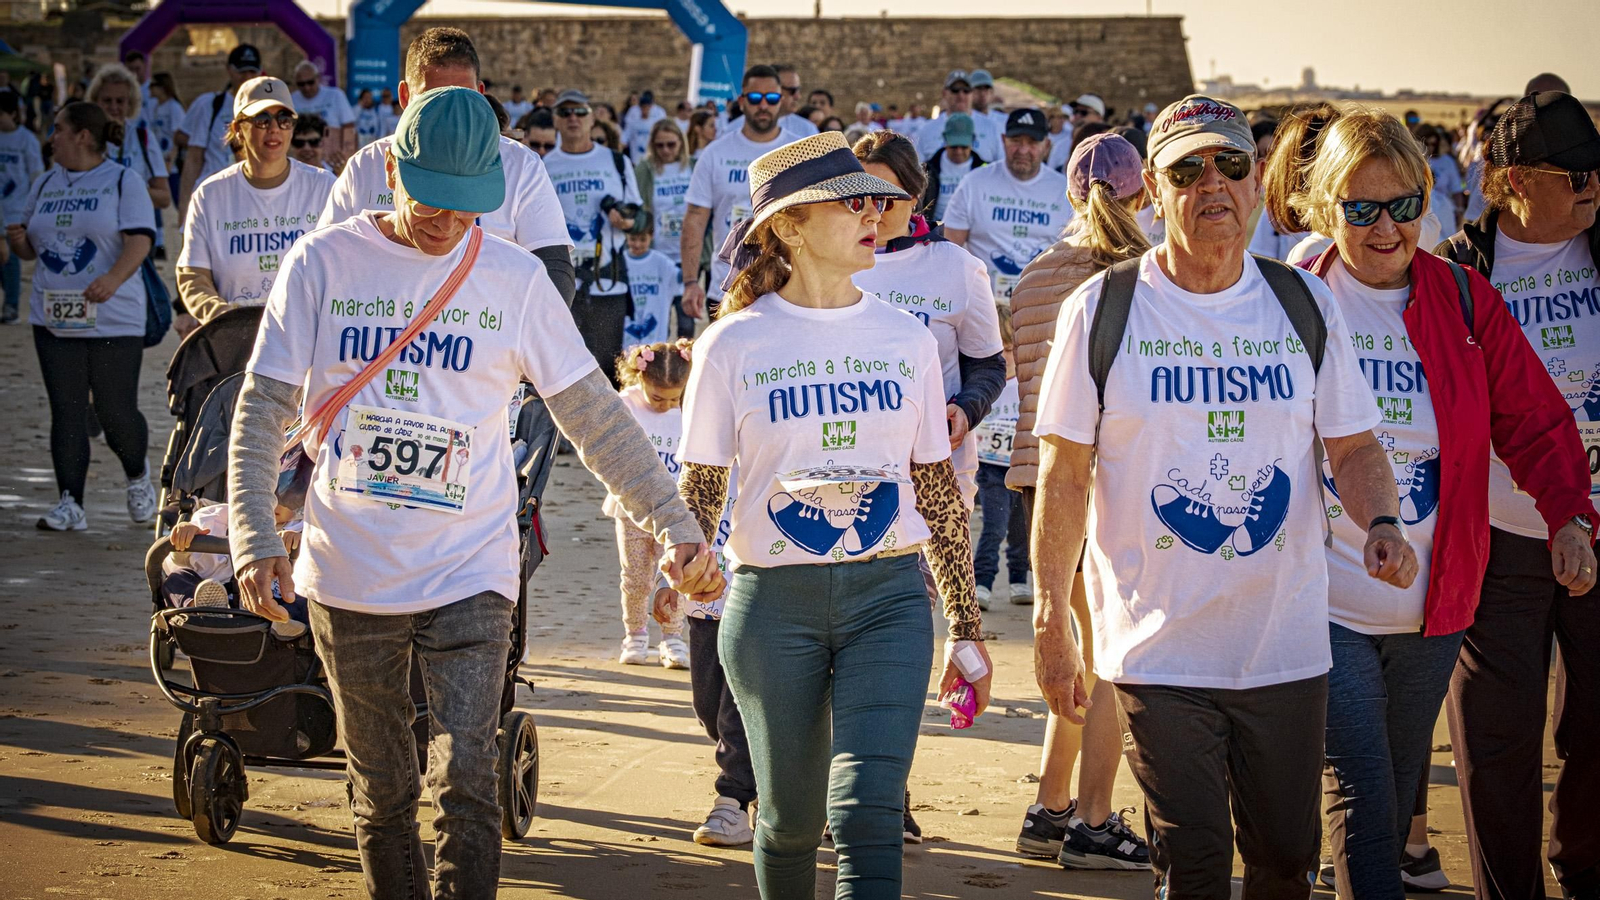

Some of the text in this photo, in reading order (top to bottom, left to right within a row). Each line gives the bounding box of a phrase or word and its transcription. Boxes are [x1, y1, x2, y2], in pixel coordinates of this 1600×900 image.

[264, 83, 273, 94] J
[38, 198, 99, 214] AUTISMO
[224, 217, 258, 231] marcha
[263, 218, 269, 228] a
[275, 215, 301, 228] favor
[992, 206, 1050, 226] AUTISMO
[631, 283, 659, 296] TISMO
[1495, 267, 1596, 294] archa a favor
[53, 302, 86, 319] 823
[888, 290, 952, 313] favor del
[330, 296, 503, 331] marcha a vor del
[1139, 336, 1203, 358] marcha
[1212, 342, 1222, 358] a
[1232, 336, 1280, 358] favor
[1285, 332, 1306, 355] de
[1384, 334, 1393, 351] a
[755, 359, 816, 386] marcha
[825, 359, 835, 375] a
[844, 356, 889, 375] favor
[898, 359, 916, 383] del
[1151, 363, 1296, 404] AUTISMO
[768, 379, 903, 424] AUTISMO
[359, 423, 413, 437] CIUDAD de CÁDIZ
[366, 414, 393, 424] MARCHA
[403, 419, 425, 429] FAVOR
[426, 423, 438, 433] DEL
[991, 433, 1013, 452] 51
[367, 436, 448, 479] 597
[367, 474, 400, 485] JAVIER
[1395, 478, 1413, 486] aso
[1167, 457, 1282, 522] Cada paso cuenta
[827, 507, 858, 525] paso
